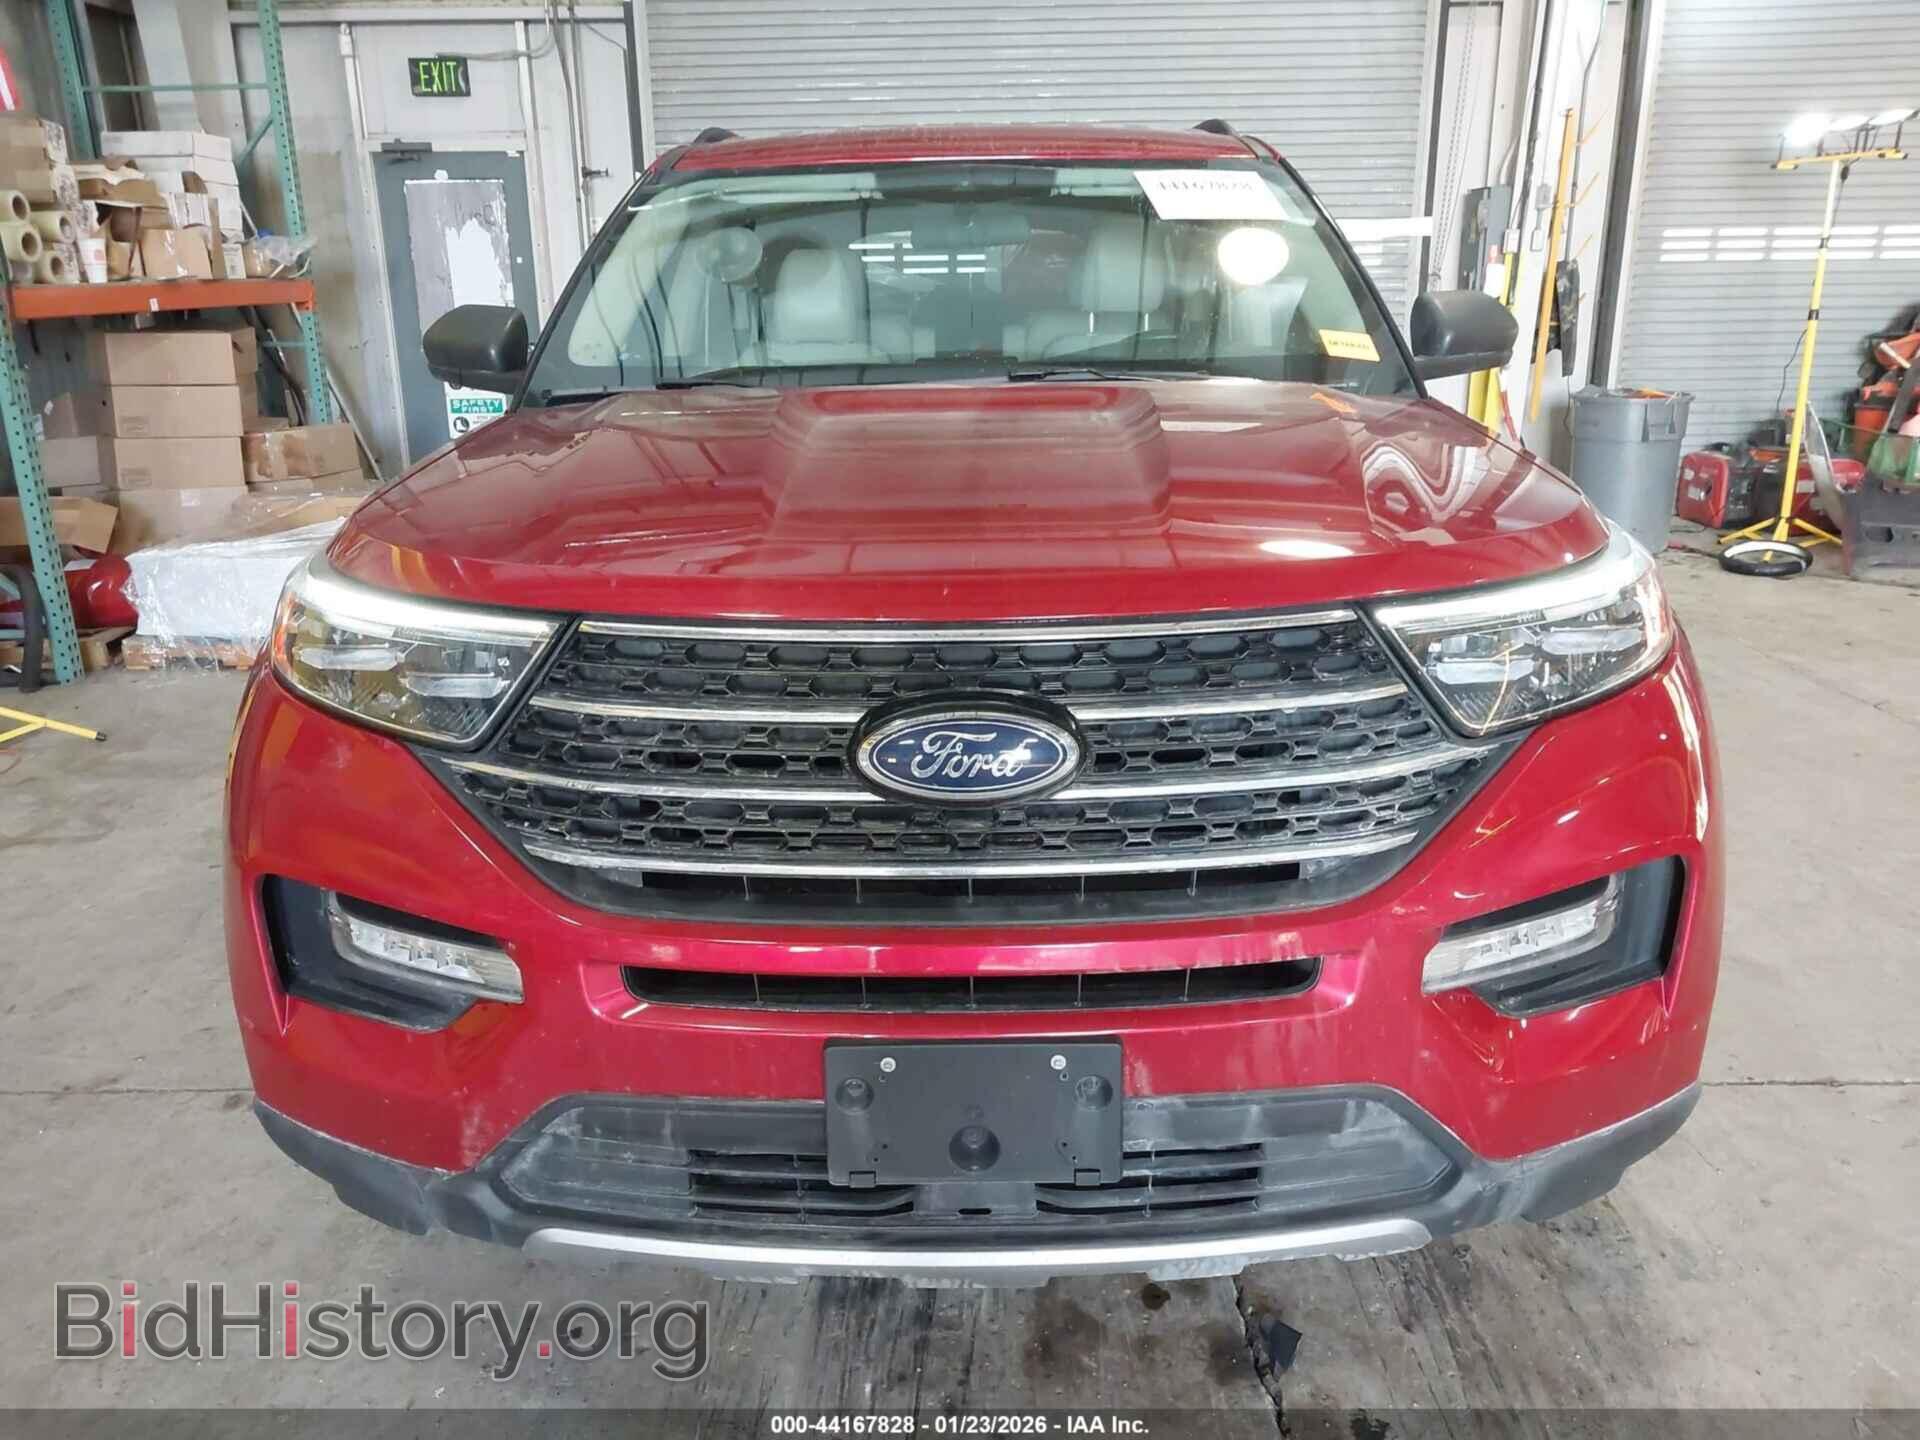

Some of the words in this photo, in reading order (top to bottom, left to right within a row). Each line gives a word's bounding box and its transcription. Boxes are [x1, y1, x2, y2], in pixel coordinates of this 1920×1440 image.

[418, 61, 457, 92] EXIT
[452, 399, 501, 409] SAFETY
[910, 731, 1038, 778] Ford
